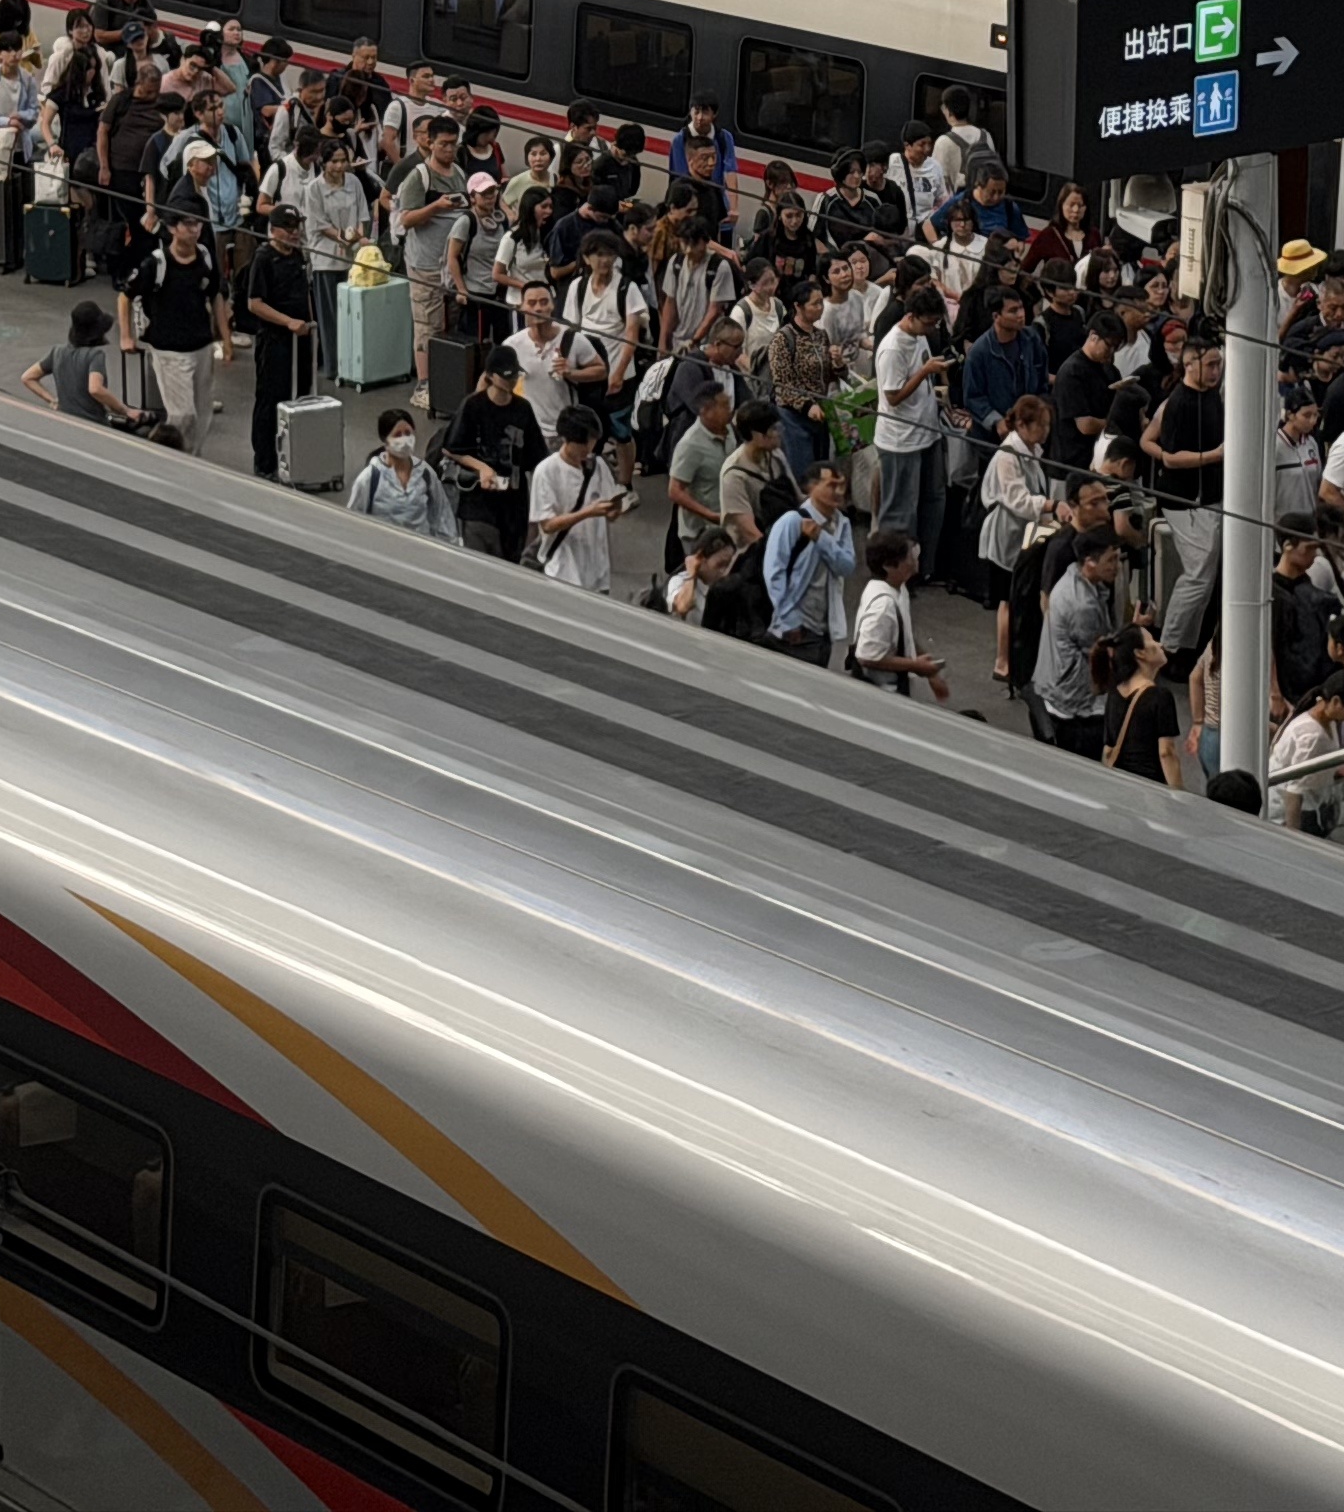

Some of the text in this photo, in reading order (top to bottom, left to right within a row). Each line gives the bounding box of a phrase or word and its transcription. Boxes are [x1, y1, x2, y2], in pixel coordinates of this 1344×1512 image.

[1123, 22, 1193, 61] 出站口
[1098, 92, 1193, 139] 便捷换乘
